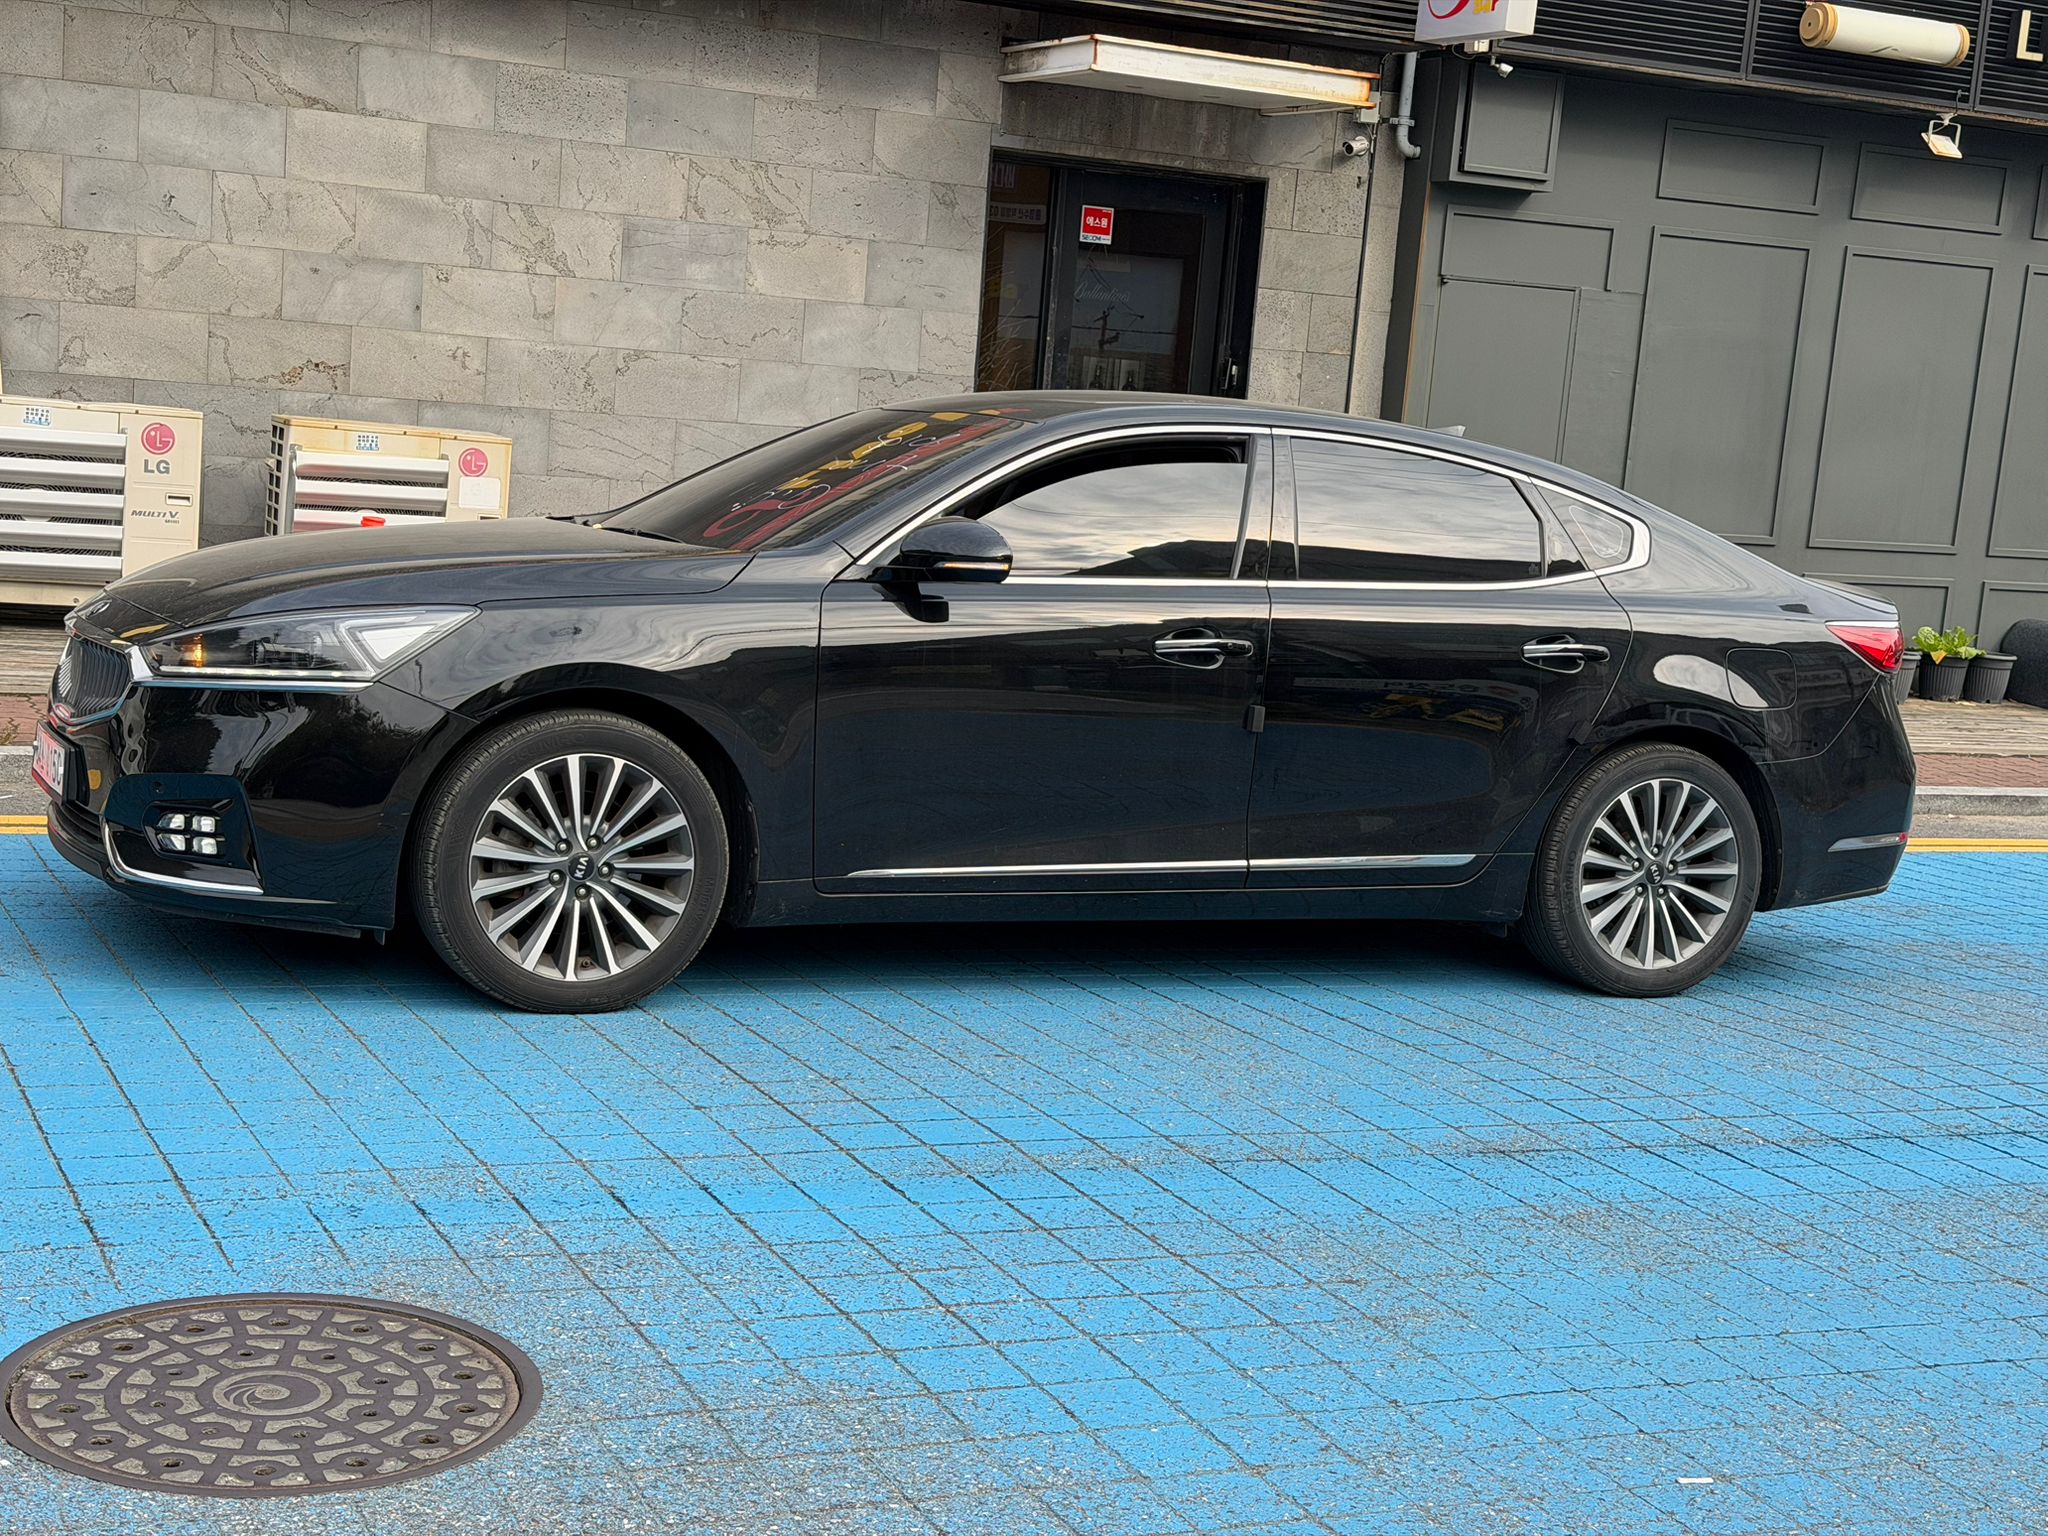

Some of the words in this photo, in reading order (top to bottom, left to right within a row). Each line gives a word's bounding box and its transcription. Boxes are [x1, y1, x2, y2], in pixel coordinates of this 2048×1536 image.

[2016, 9, 2044, 62] L
[1086, 216, 1108, 229] 에스원
[143, 459, 171, 474] LG
[131, 510, 167, 518] MULTI
[168, 510, 180, 519] V
[574, 857, 589, 878] KIA
[1650, 864, 1661, 884] KIA
